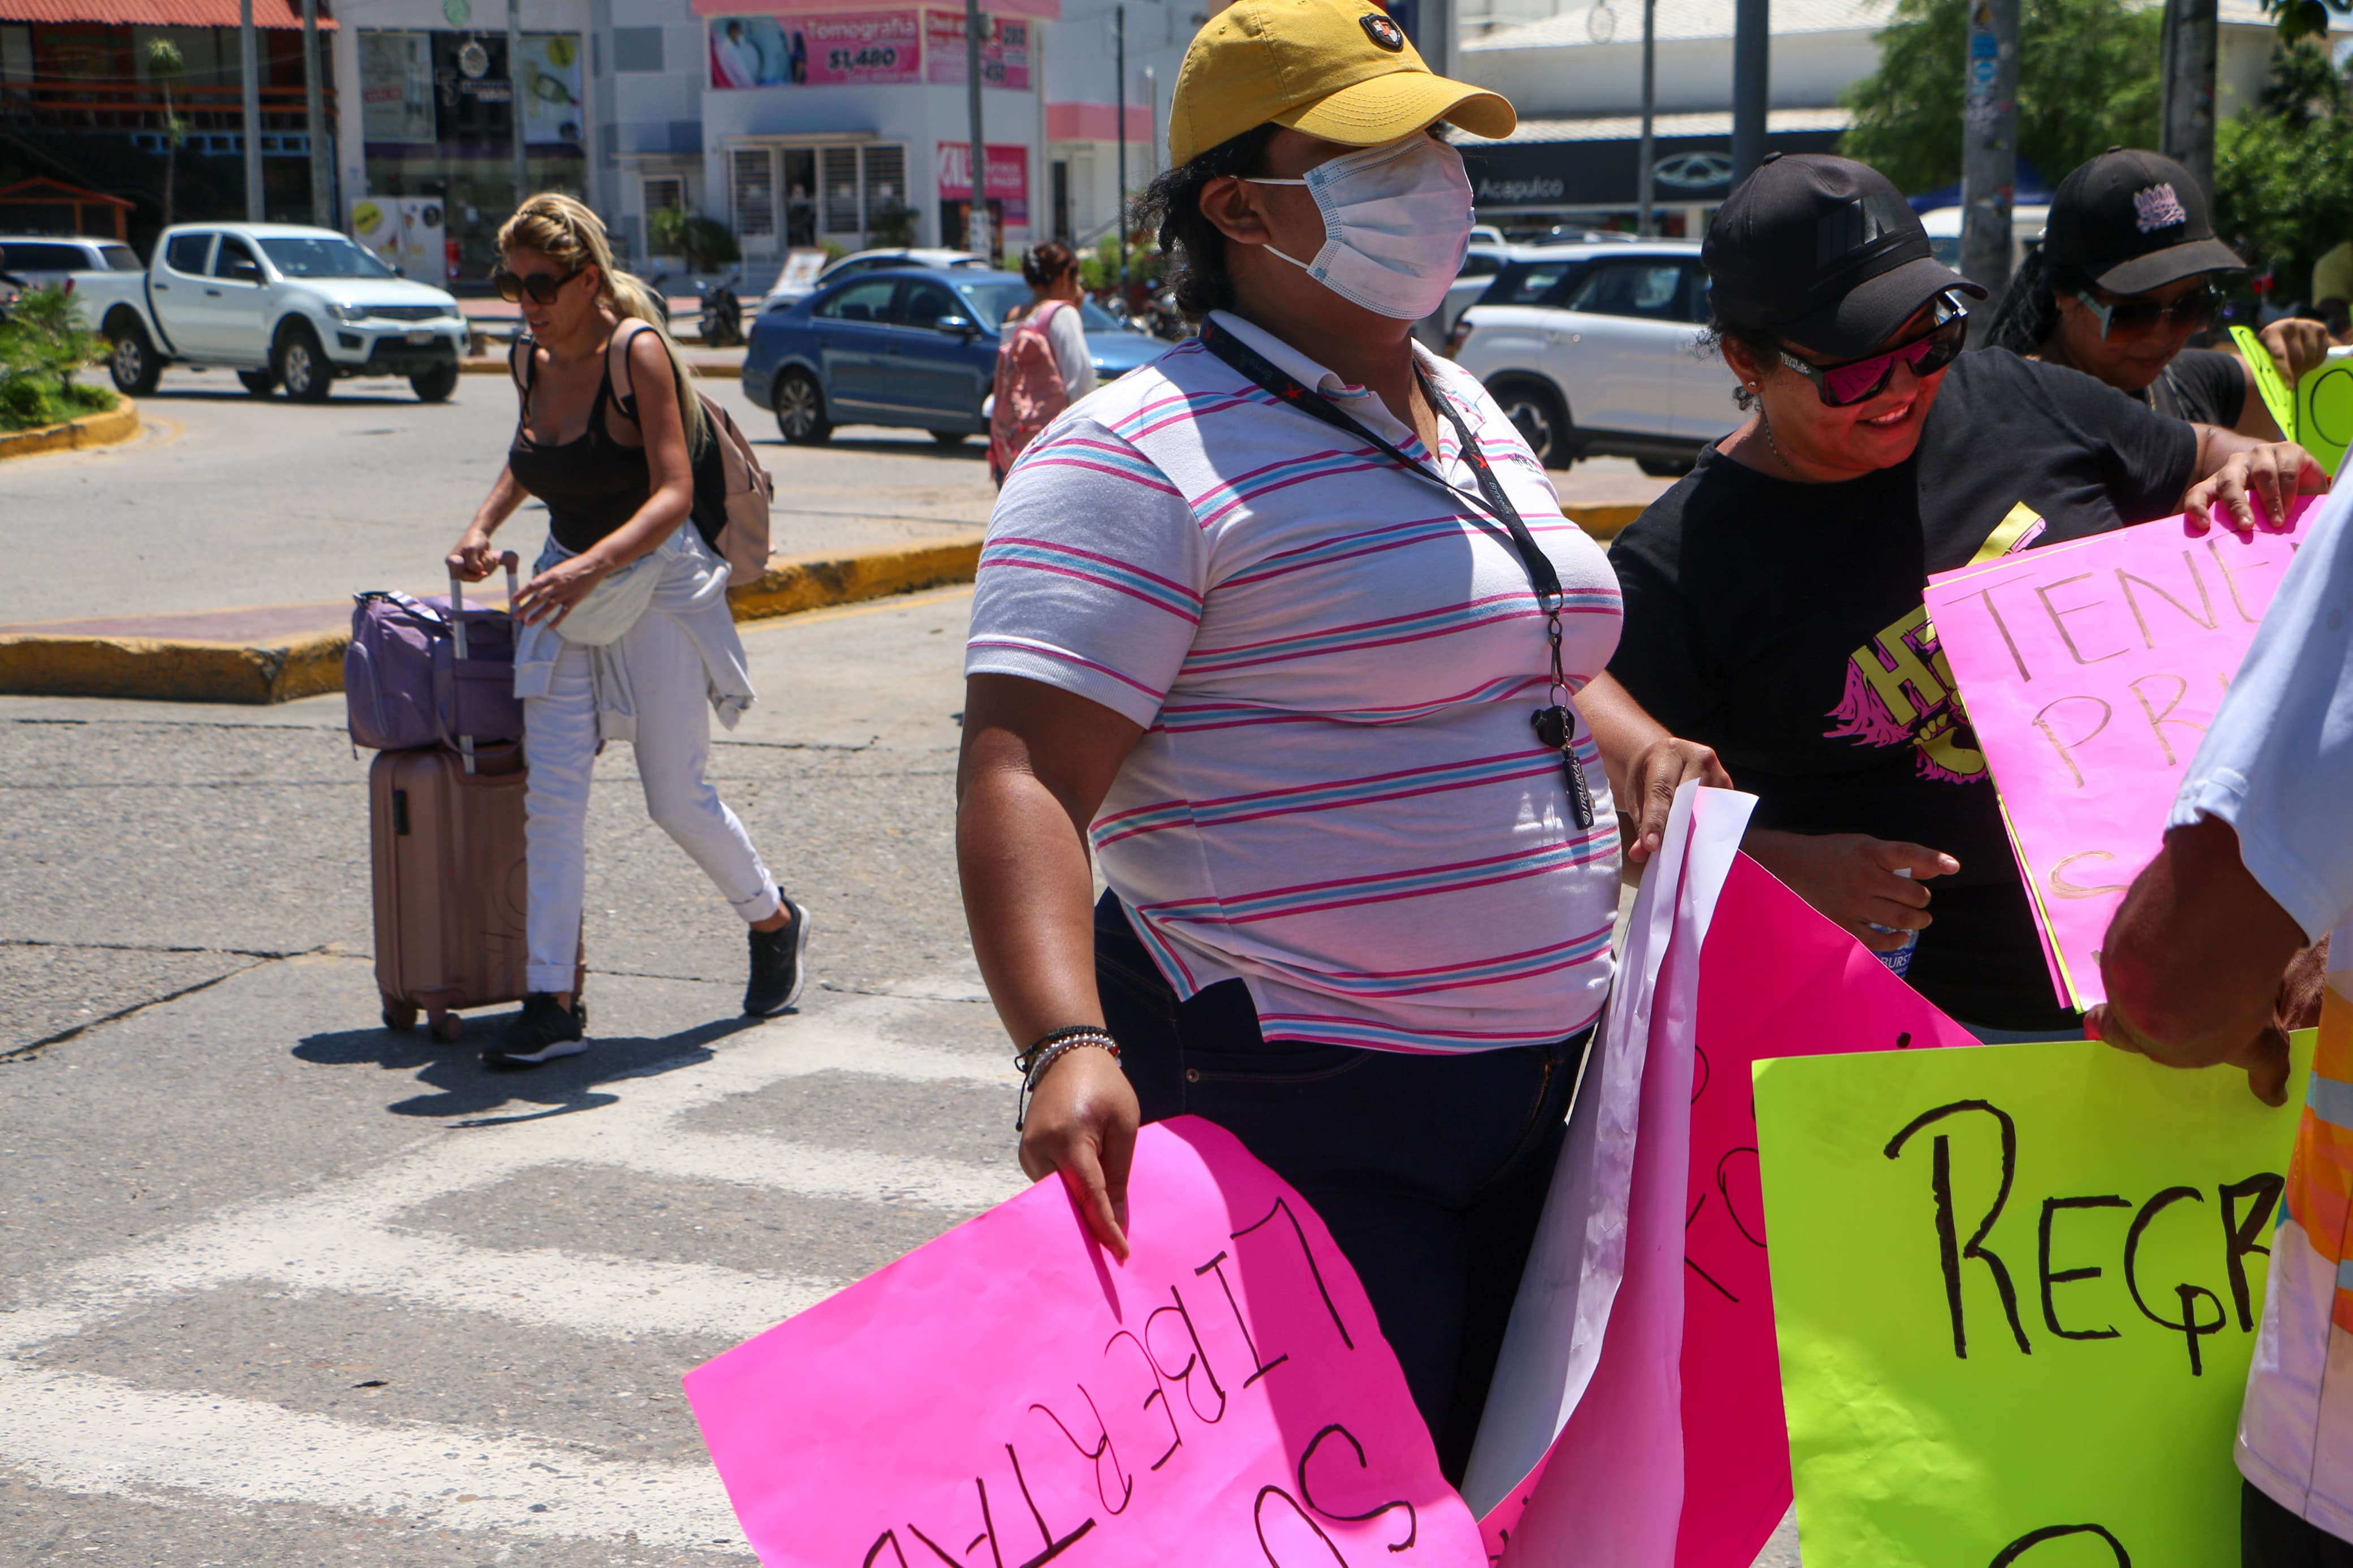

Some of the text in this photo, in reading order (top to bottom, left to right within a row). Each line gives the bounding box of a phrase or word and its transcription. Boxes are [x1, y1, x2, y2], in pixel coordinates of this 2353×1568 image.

[1477, 176, 1565, 202] Acapulco
[1572, 763, 1588, 810] ITALIKA
[863, 1196, 1355, 1568] LIBERTA
